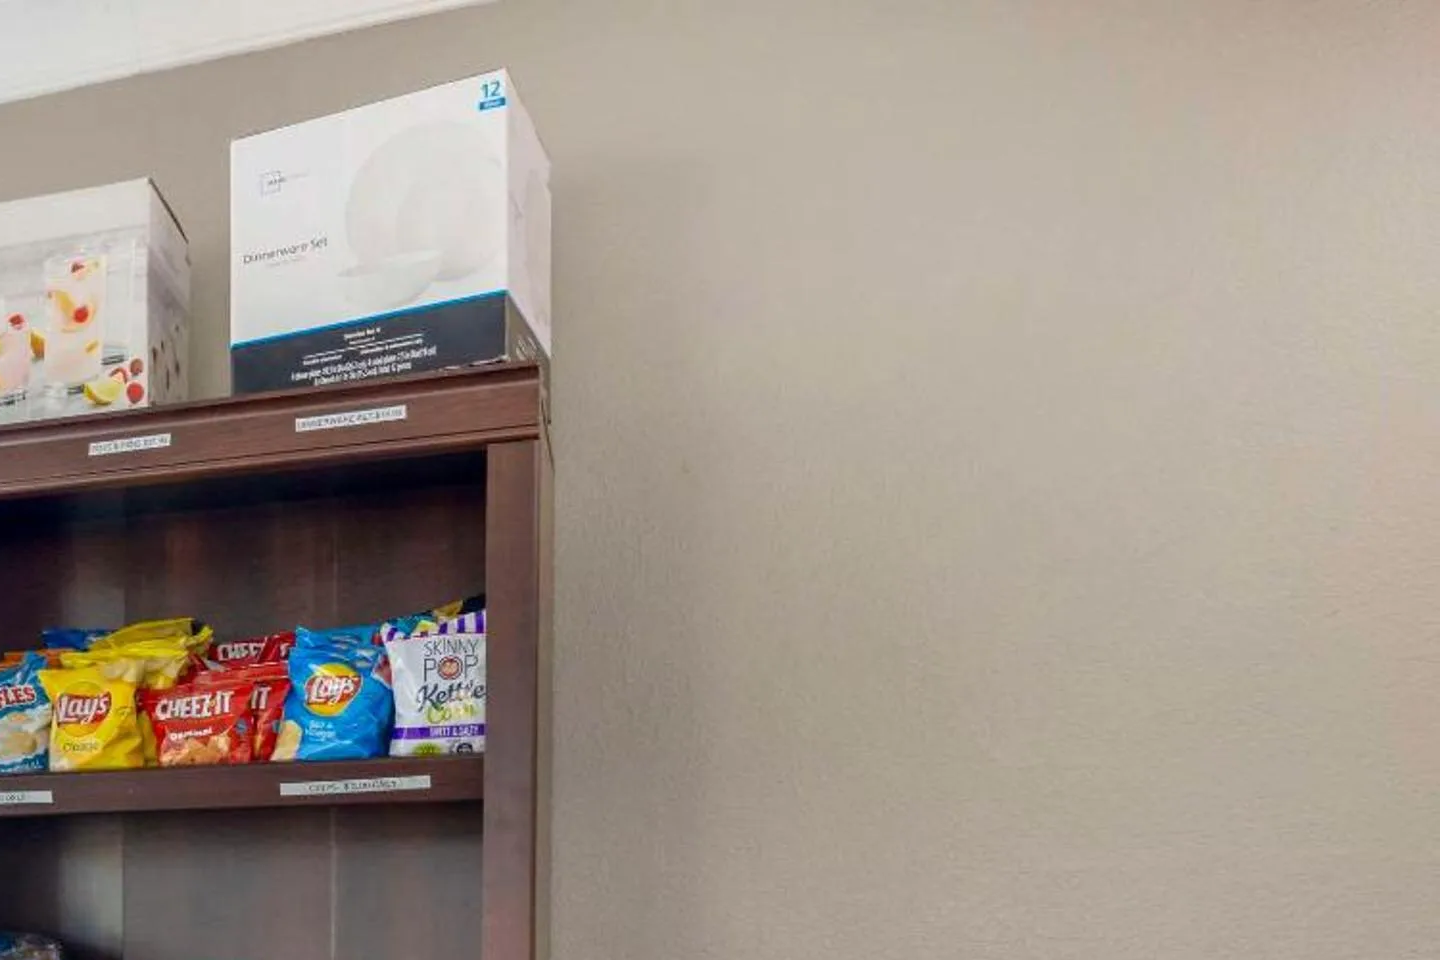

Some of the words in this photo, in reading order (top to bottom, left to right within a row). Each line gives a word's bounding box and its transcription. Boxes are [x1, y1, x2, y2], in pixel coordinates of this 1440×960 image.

[481, 80, 501, 98] 12
[423, 639, 481, 657] SKINNY
[423, 654, 480, 682] POP
[58, 692, 111, 726] Lay's
[417, 679, 486, 712] Kettle
